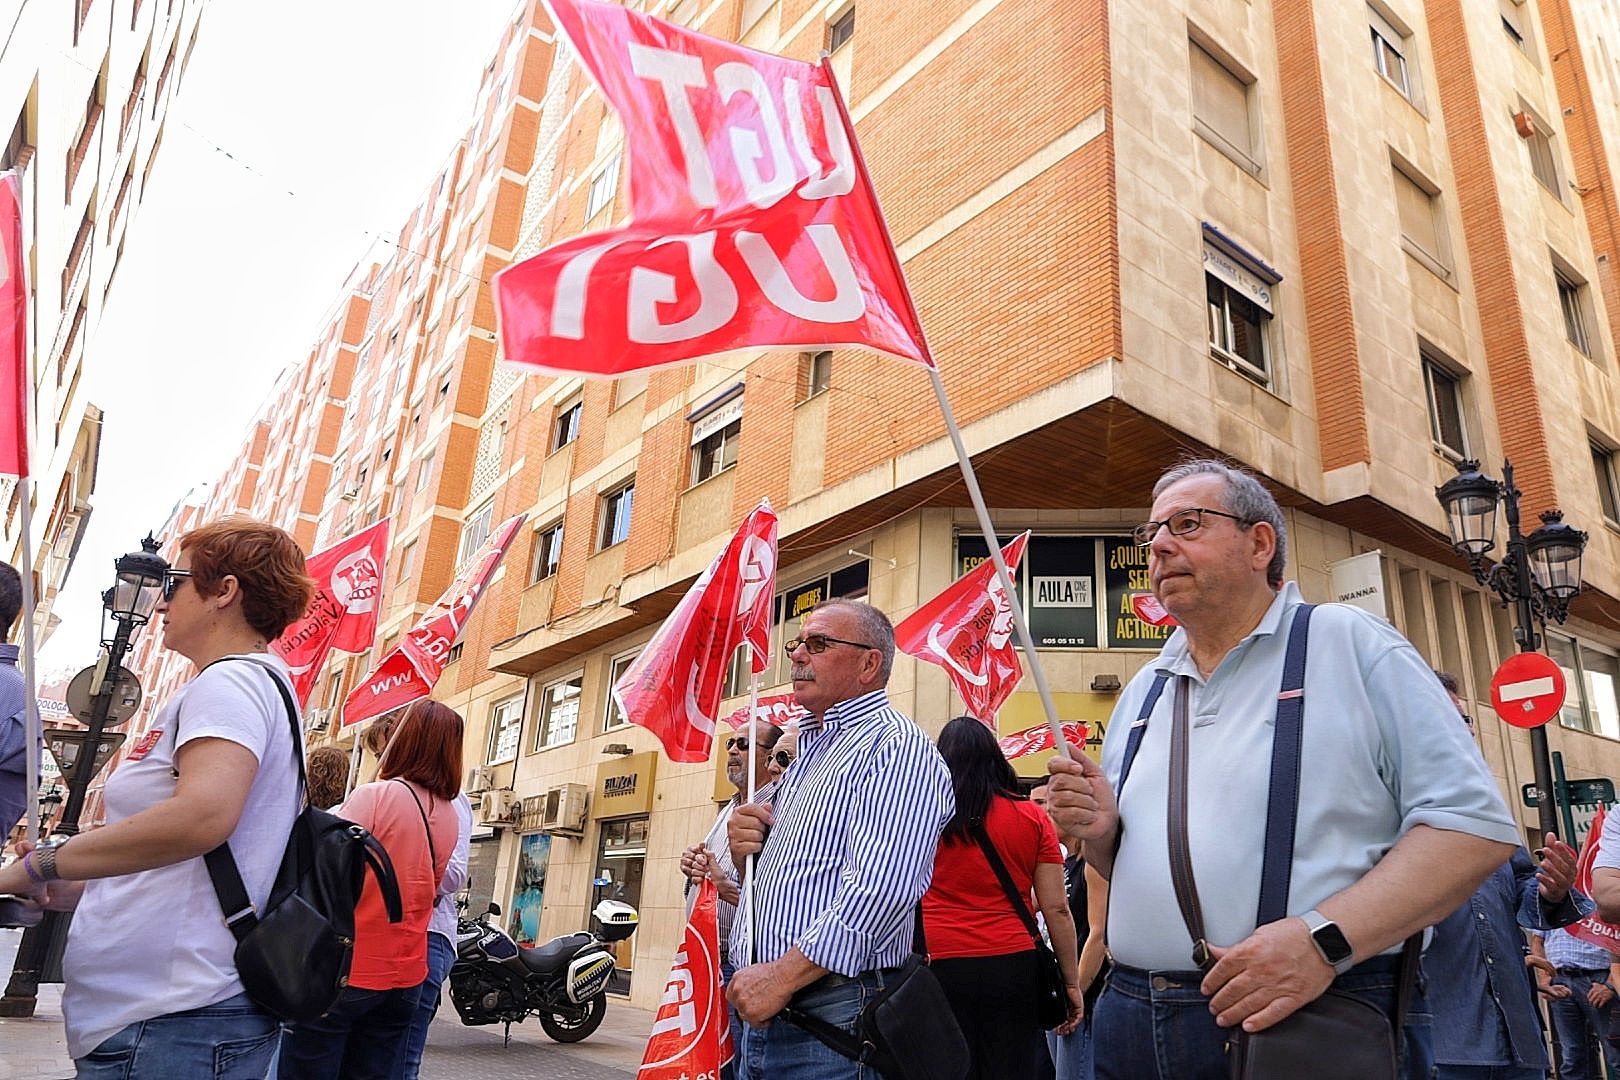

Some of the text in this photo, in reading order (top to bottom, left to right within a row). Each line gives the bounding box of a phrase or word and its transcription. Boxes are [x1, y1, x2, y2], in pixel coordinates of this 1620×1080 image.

[1038, 580, 1074, 602] AULA
[1074, 580, 1087, 592] CINE
[1074, 592, 1087, 602] Y TV
